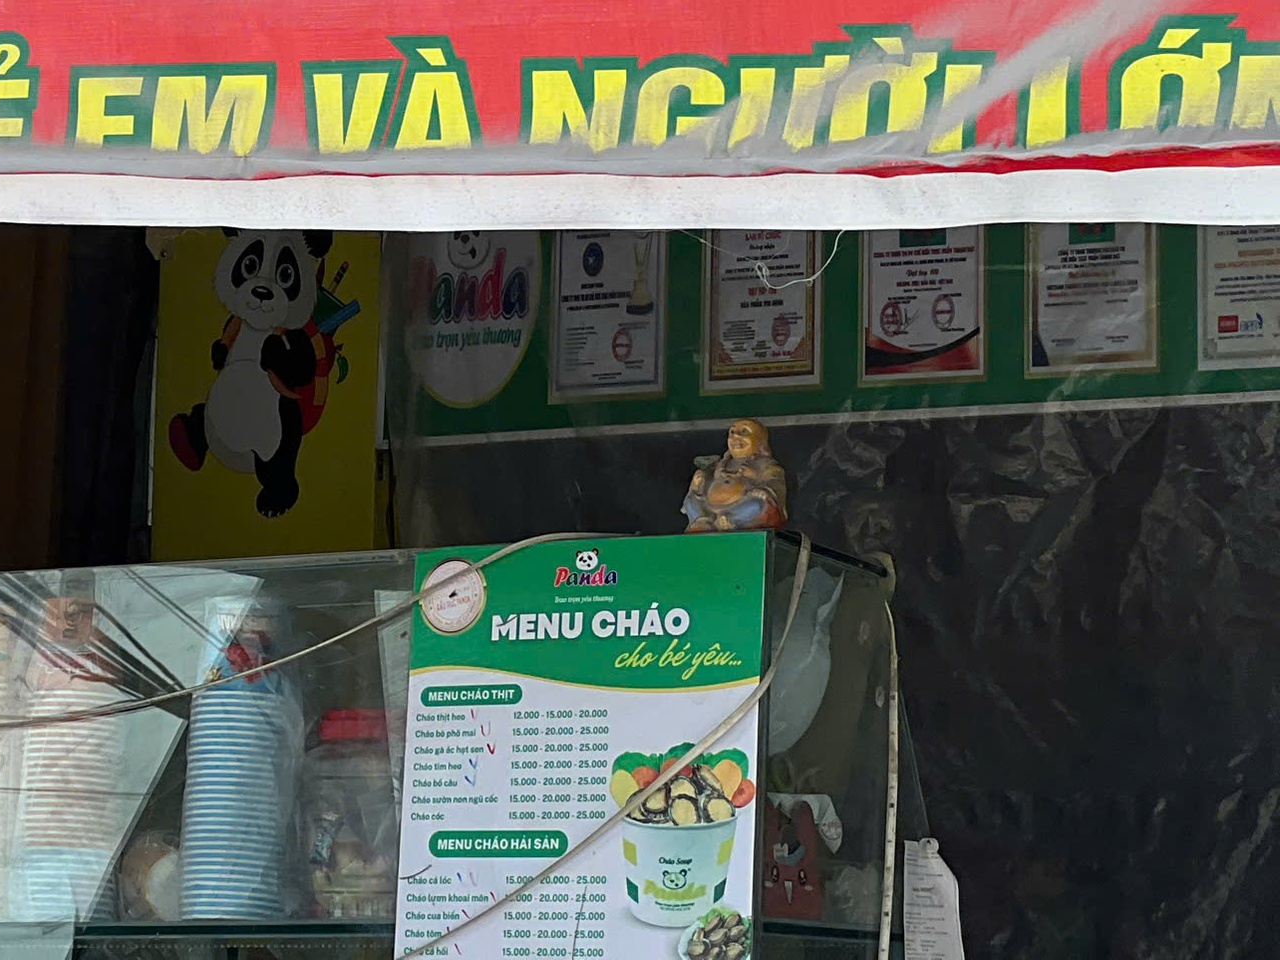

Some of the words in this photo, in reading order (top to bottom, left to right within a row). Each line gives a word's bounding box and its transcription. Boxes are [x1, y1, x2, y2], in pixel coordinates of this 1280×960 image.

[302, 35, 480, 154] VÀ
[554, 564, 617, 587] Panda
[491, 611, 583, 641] MENU
[591, 602, 690, 637] CHÁO
[614, 642, 657, 668] cho
[658, 639, 690, 667] bé
[428, 691, 459, 701] MENU
[461, 688, 490, 700] CHÁO
[492, 690, 515, 702] THỊT
[437, 714, 450, 723] thịt
[451, 713, 466, 721] heo
[513, 711, 540, 720] 12.000
[546, 711, 573, 719] 15.000
[579, 710, 608, 718] 20.000
[415, 730, 435, 738] Cháo
[462, 729, 476, 737] mai
[512, 728, 539, 736] 15.000
[545, 727, 574, 735] 20.000
[580, 727, 609, 735] 25.000
[415, 747, 434, 755] Cháo
[435, 746, 445, 756] gà
[512, 744, 538, 753] 15.000
[544, 744, 573, 752] 20.000
[579, 743, 608, 752] 25.000
[413, 763, 433, 771] Cháo
[434, 763, 447, 771] tim
[511, 761, 538, 770] 15.000
[544, 761, 572, 769] 20.000
[579, 760, 607, 768] 25.000
[510, 778, 537, 786] 15.000
[543, 777, 572, 786] 20.000
[578, 777, 607, 785] 25.000
[412, 796, 431, 804] Cháo
[509, 795, 536, 803] 15.000
[543, 794, 571, 803] 20.000
[577, 794, 606, 802] 25.000
[509, 811, 535, 820] 15.000
[541, 811, 570, 820] 20.000
[577, 811, 606, 819] 25.000
[438, 839, 471, 850] MENU
[474, 836, 507, 850] CHÁO
[510, 835, 532, 850] HẢI
[534, 835, 559, 850] SẢN
[408, 876, 427, 884] Cháo
[429, 876, 437, 884] cá
[439, 876, 452, 884] lóc
[540, 876, 570, 885] 20.000
[577, 876, 607, 885] 25.000
[407, 894, 426, 902] Cháo
[448, 894, 470, 902] khoai
[472, 894, 489, 902] môn
[540, 894, 569, 903] 20.000
[576, 894, 606, 903] 25.000
[406, 912, 426, 920] Cháo
[504, 912, 532, 920] 15.000
[538, 912, 568, 920] 20.000
[575, 912, 605, 920] 25.000
[405, 930, 425, 938] Cháo
[503, 930, 531, 938] 15.000
[537, 930, 567, 938] 20.000
[575, 930, 605, 938] 25.000
[502, 948, 530, 956] 15.000
[537, 948, 567, 957] 20.000
[573, 948, 604, 957] 25.000
